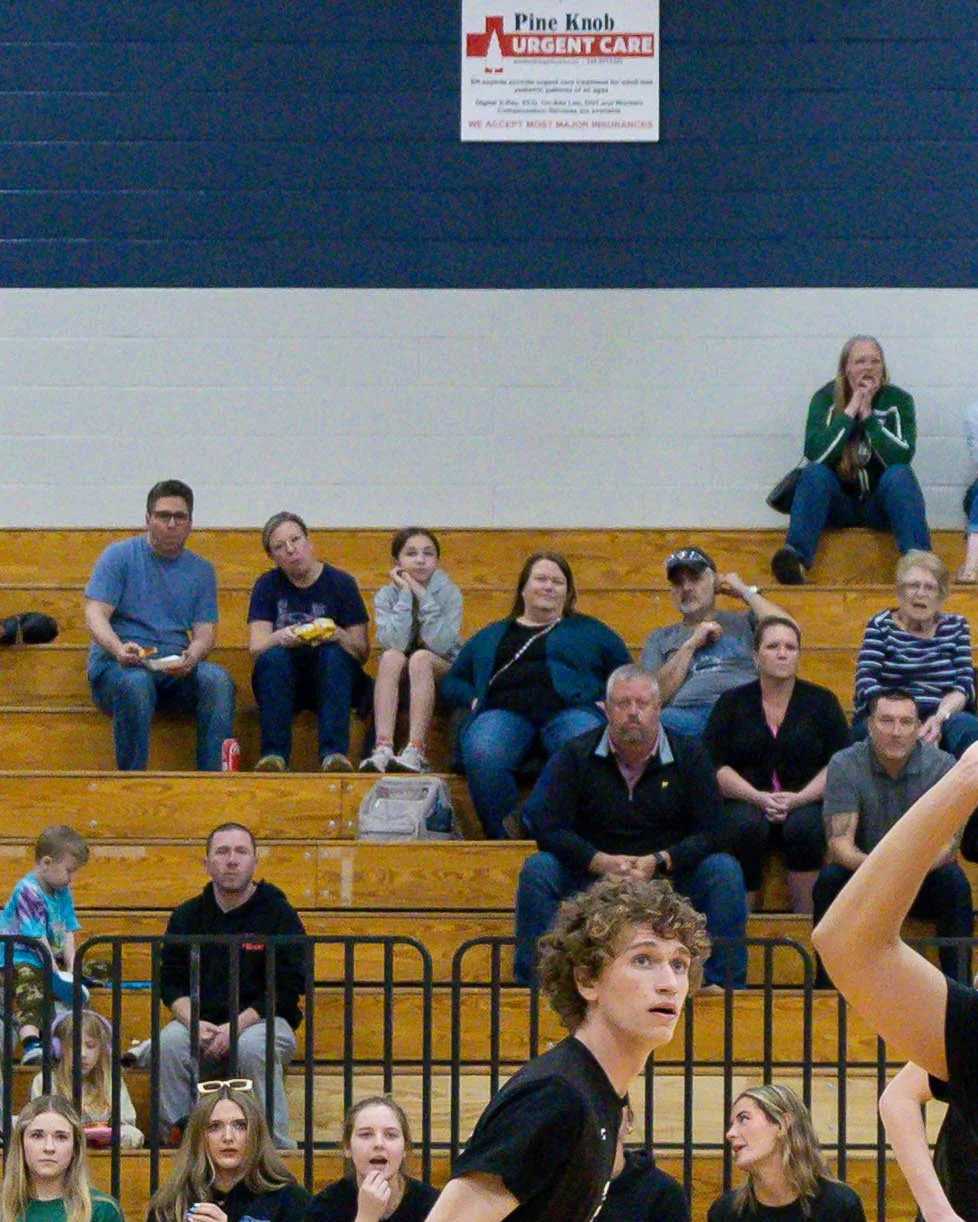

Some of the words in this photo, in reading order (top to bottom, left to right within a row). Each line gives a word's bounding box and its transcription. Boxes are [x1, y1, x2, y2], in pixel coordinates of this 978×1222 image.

[514, 12, 558, 31] Pine
[565, 12, 615, 31] Knob
[512, 36, 595, 54] URGENT
[599, 36, 653, 54] CARE
